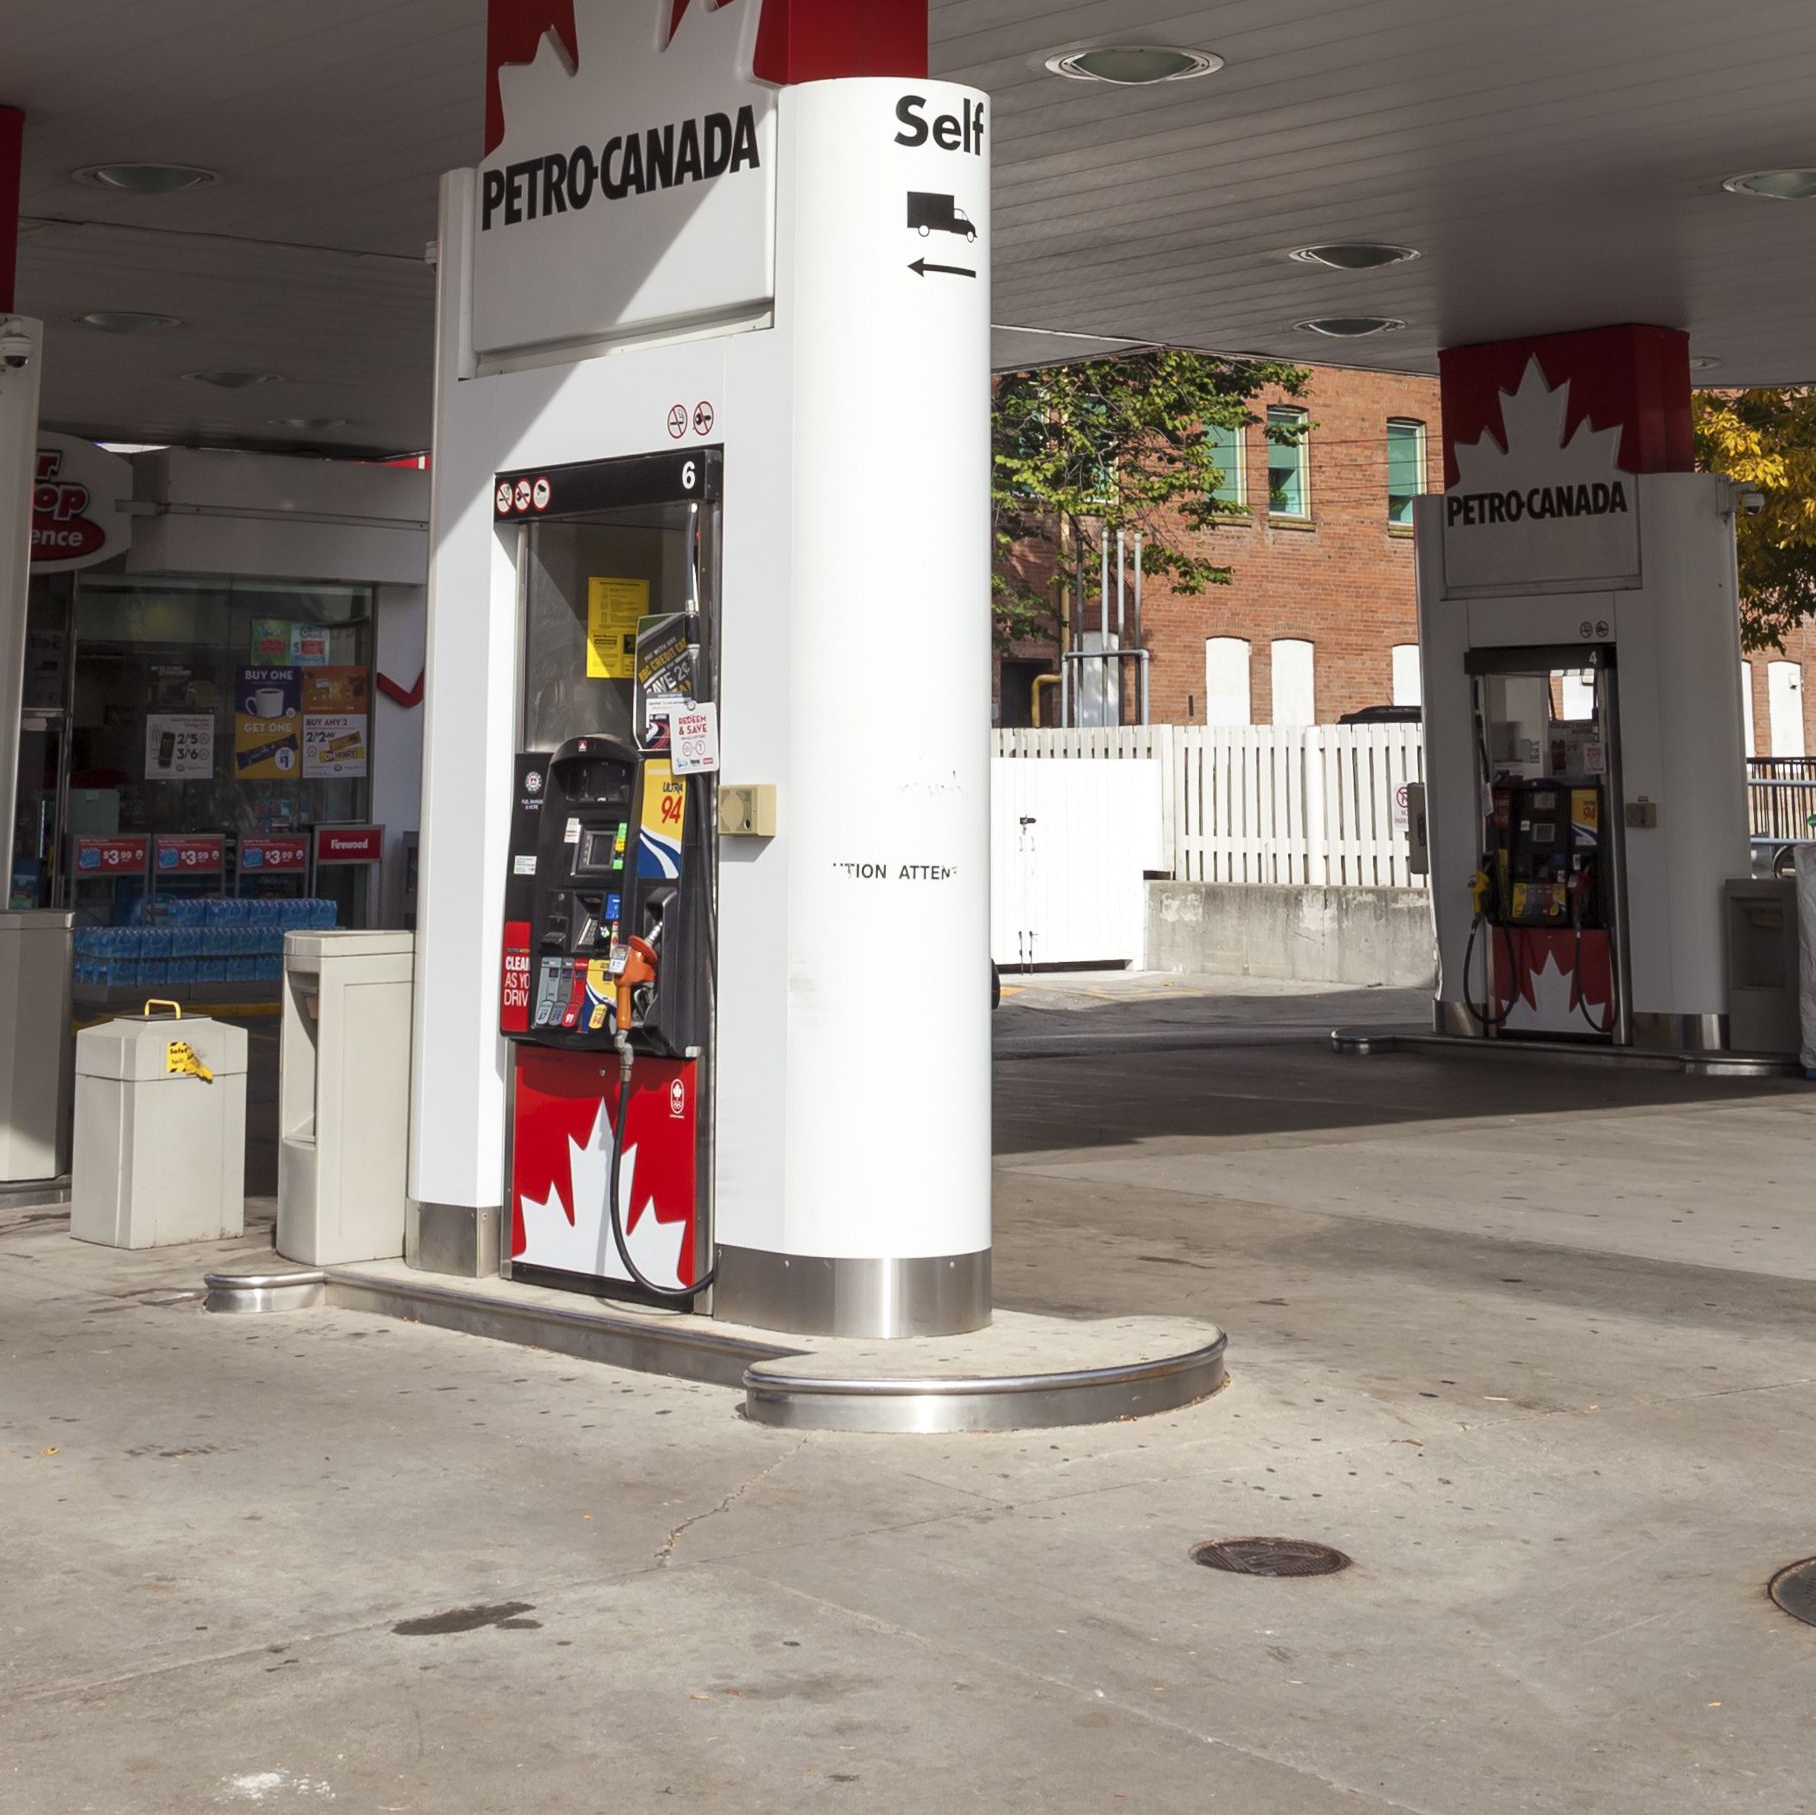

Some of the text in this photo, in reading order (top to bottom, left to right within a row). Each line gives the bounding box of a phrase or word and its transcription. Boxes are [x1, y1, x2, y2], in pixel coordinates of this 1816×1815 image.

[893, 94, 984, 157] Self
[681, 460, 696, 490] 6
[1589, 651, 1598, 665] 4
[244, 670, 294, 681] BUY ONE
[678, 714, 707, 725] REDEEM
[243, 722, 293, 733] GET ONE
[686, 724, 708, 734] SAVE
[662, 781, 683, 794] ULTRA
[661, 795, 683, 824] 94
[331, 837, 369, 850] Firewood
[898, 864, 958, 881] ATTEN
[505, 972, 518, 988] AS
